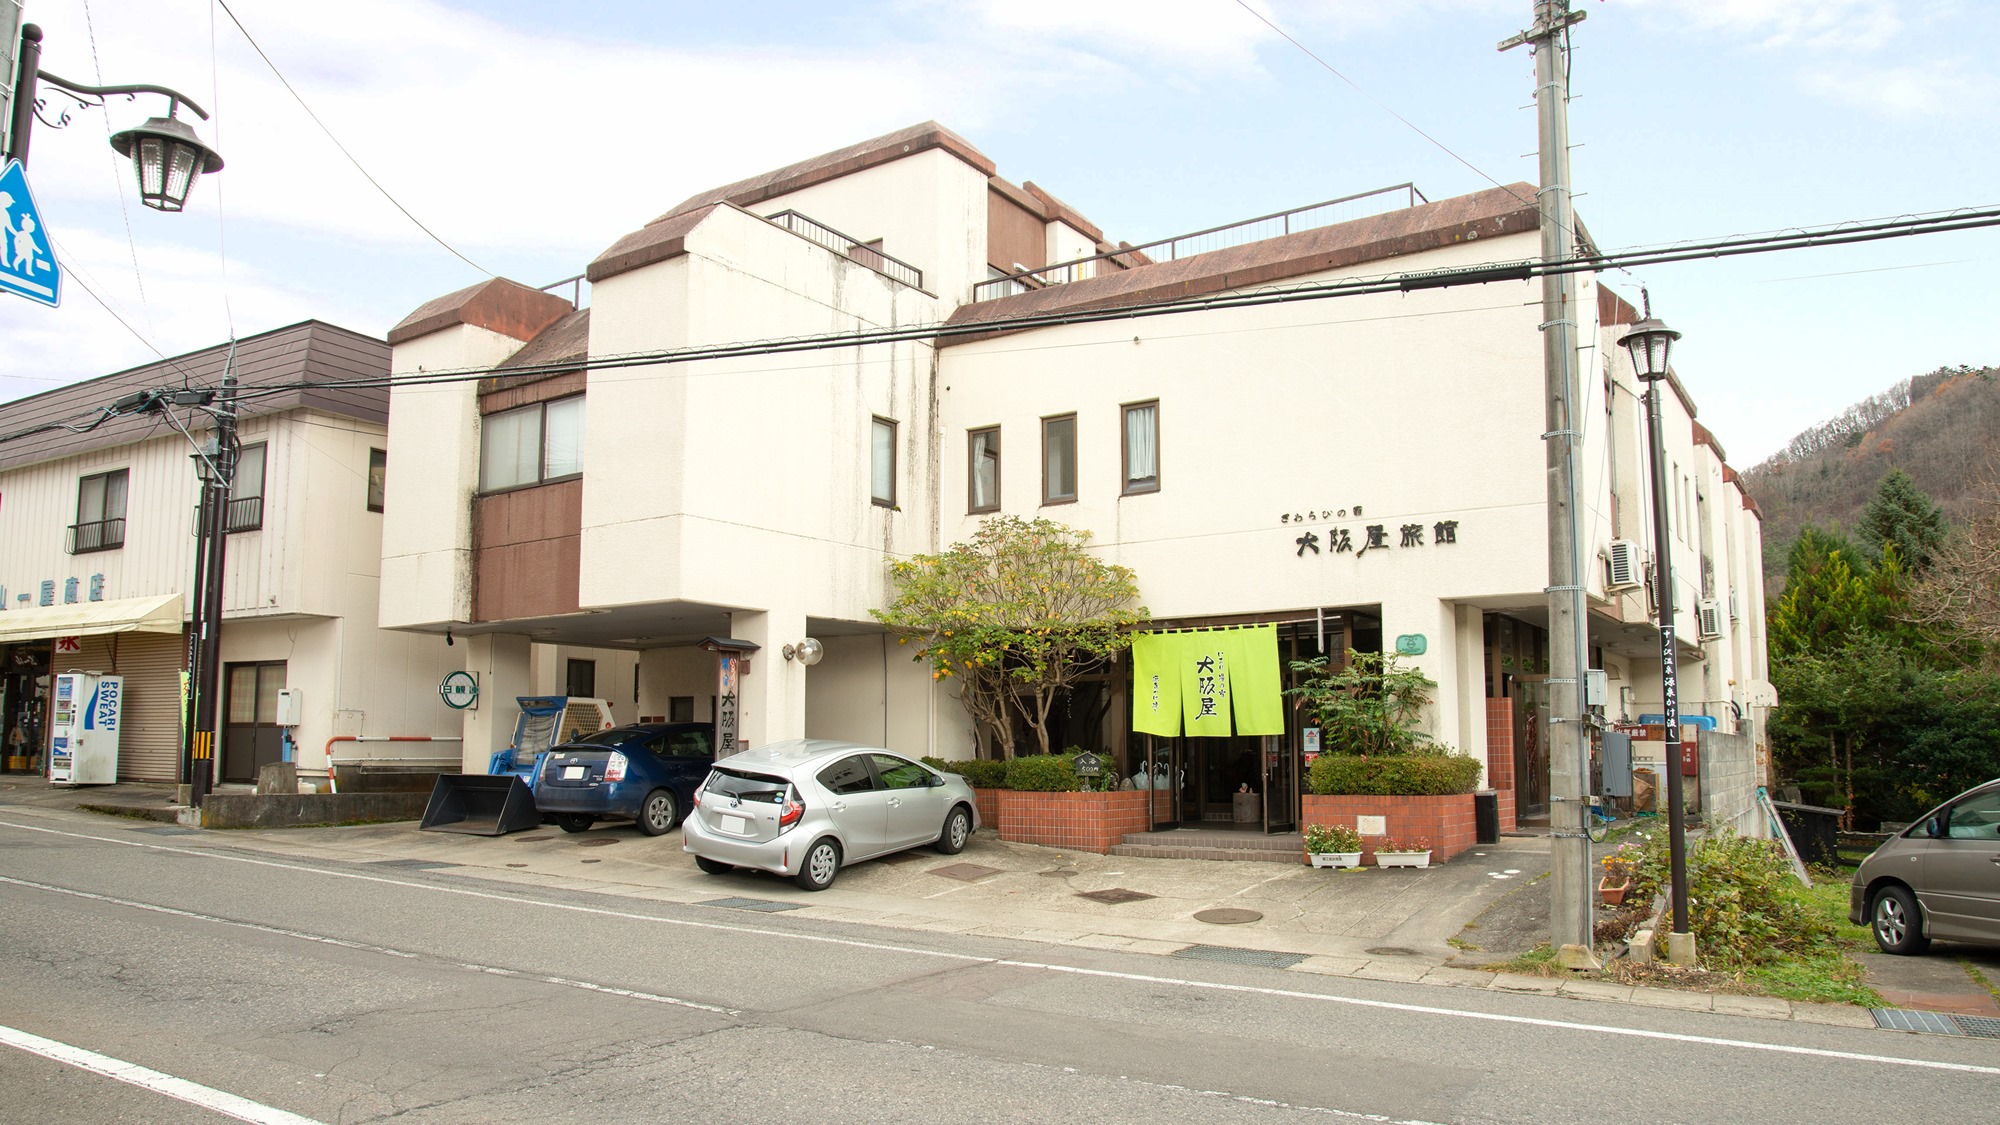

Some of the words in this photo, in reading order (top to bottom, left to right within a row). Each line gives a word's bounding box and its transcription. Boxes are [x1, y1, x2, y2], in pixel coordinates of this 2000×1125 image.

[1295, 520, 1459, 559] 大阪屋旅館
[98, 681, 110, 727] SWEAT
[106, 681, 119, 731] POCARI
[1195, 655, 1217, 720] 大阪屋
[719, 690, 736, 753] 大阪屋
